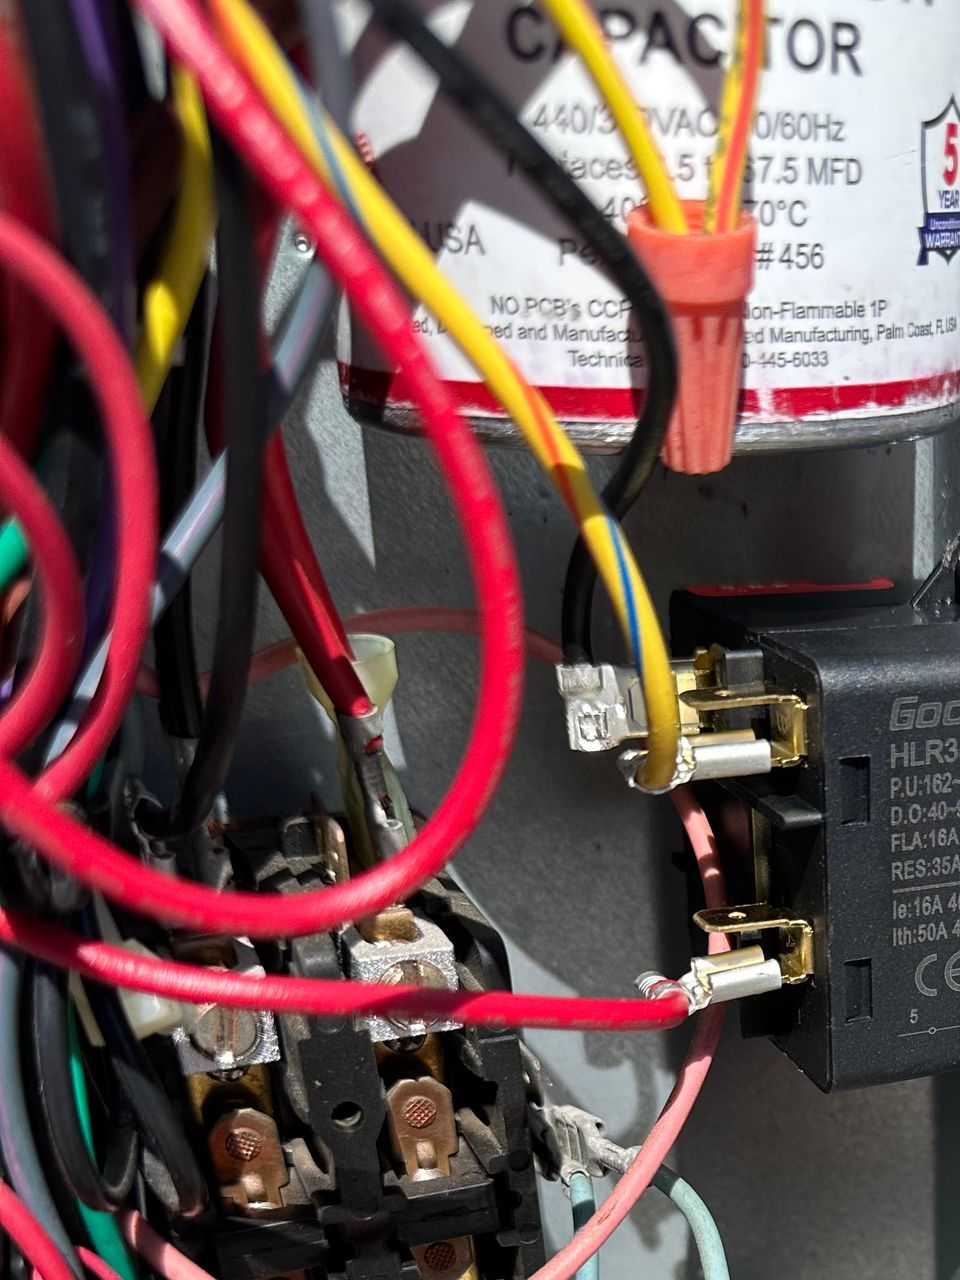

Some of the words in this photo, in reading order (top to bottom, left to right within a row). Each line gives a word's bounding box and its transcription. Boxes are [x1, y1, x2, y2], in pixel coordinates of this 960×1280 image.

[507, 6, 863, 77] CPACTOR
[943, 122, 959, 187] 5
[807, 157, 863, 186] MFD
[938, 189, 960, 210] YEAR
[490, 294, 519, 316] NO
[525, 296, 582, 321] PCB's
[517, 324, 547, 341] and
[769, 326, 873, 345] Manufacturing,
[876, 322, 904, 341] Palm
[907, 319, 935, 338] Coast,
[567, 350, 644, 369] Technica
[891, 826, 960, 853] FLA:16A
[909, 1008, 919, 1024] 5
